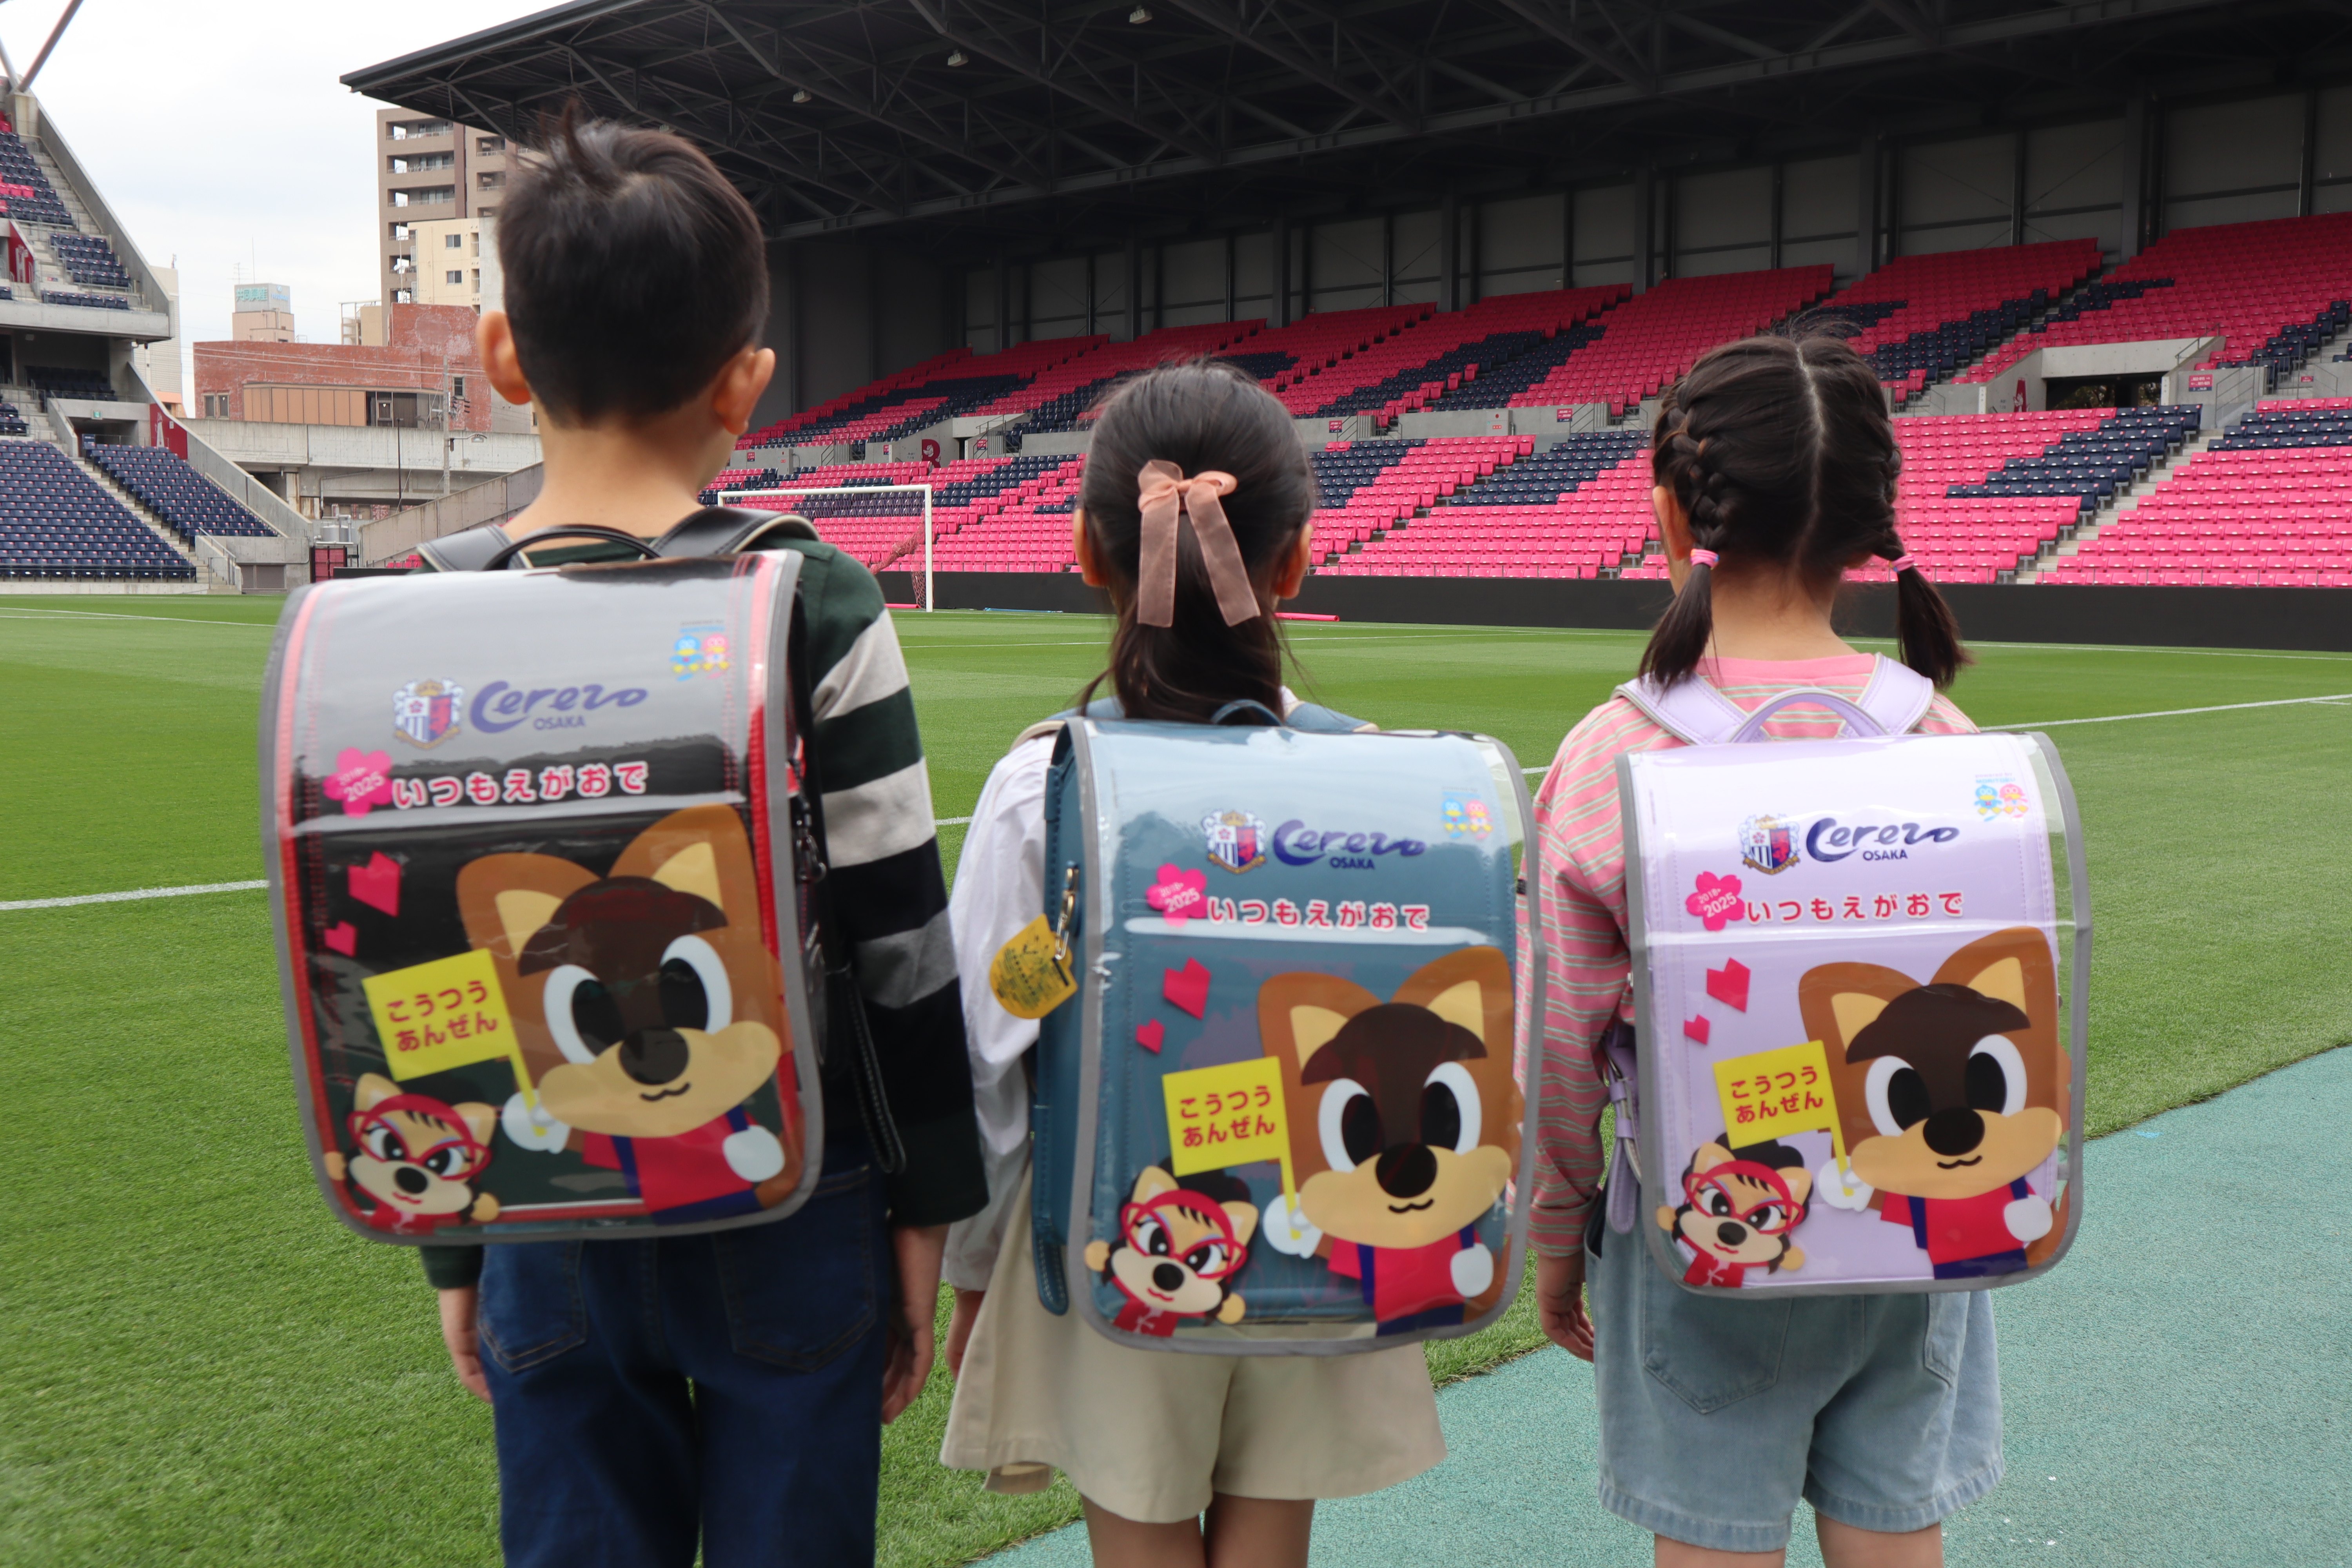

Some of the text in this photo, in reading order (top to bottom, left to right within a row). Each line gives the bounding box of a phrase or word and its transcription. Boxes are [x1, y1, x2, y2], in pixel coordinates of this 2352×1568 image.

[236, 287, 267, 301] 共同興産
[922, 439, 941, 468] R
[470, 680, 648, 733] Cerezo
[534, 716, 585, 730] OSAKA
[343, 771, 385, 802] 2025
[392, 761, 648, 809] いつもえがおで
[1273, 819, 1426, 866] Cerezo
[1806, 817, 1960, 862] Cerezo
[1862, 849, 1908, 861] OSAKA
[1329, 857, 1375, 870] OSAKA
[1164, 887, 1200, 913] 2025
[1208, 896, 1429, 933] いつもえがおで
[1703, 892, 1737, 918] 2025
[1747, 891, 1964, 924] いつもえがおで
[387, 981, 487, 1022] こうつう
[395, 1011, 498, 1052] あんぜん
[1731, 1066, 1817, 1099] こうつう
[1180, 1085, 1270, 1118] こうつう
[1735, 1091, 1823, 1124] あんぜん
[1183, 1114, 1275, 1147] あんぜん
